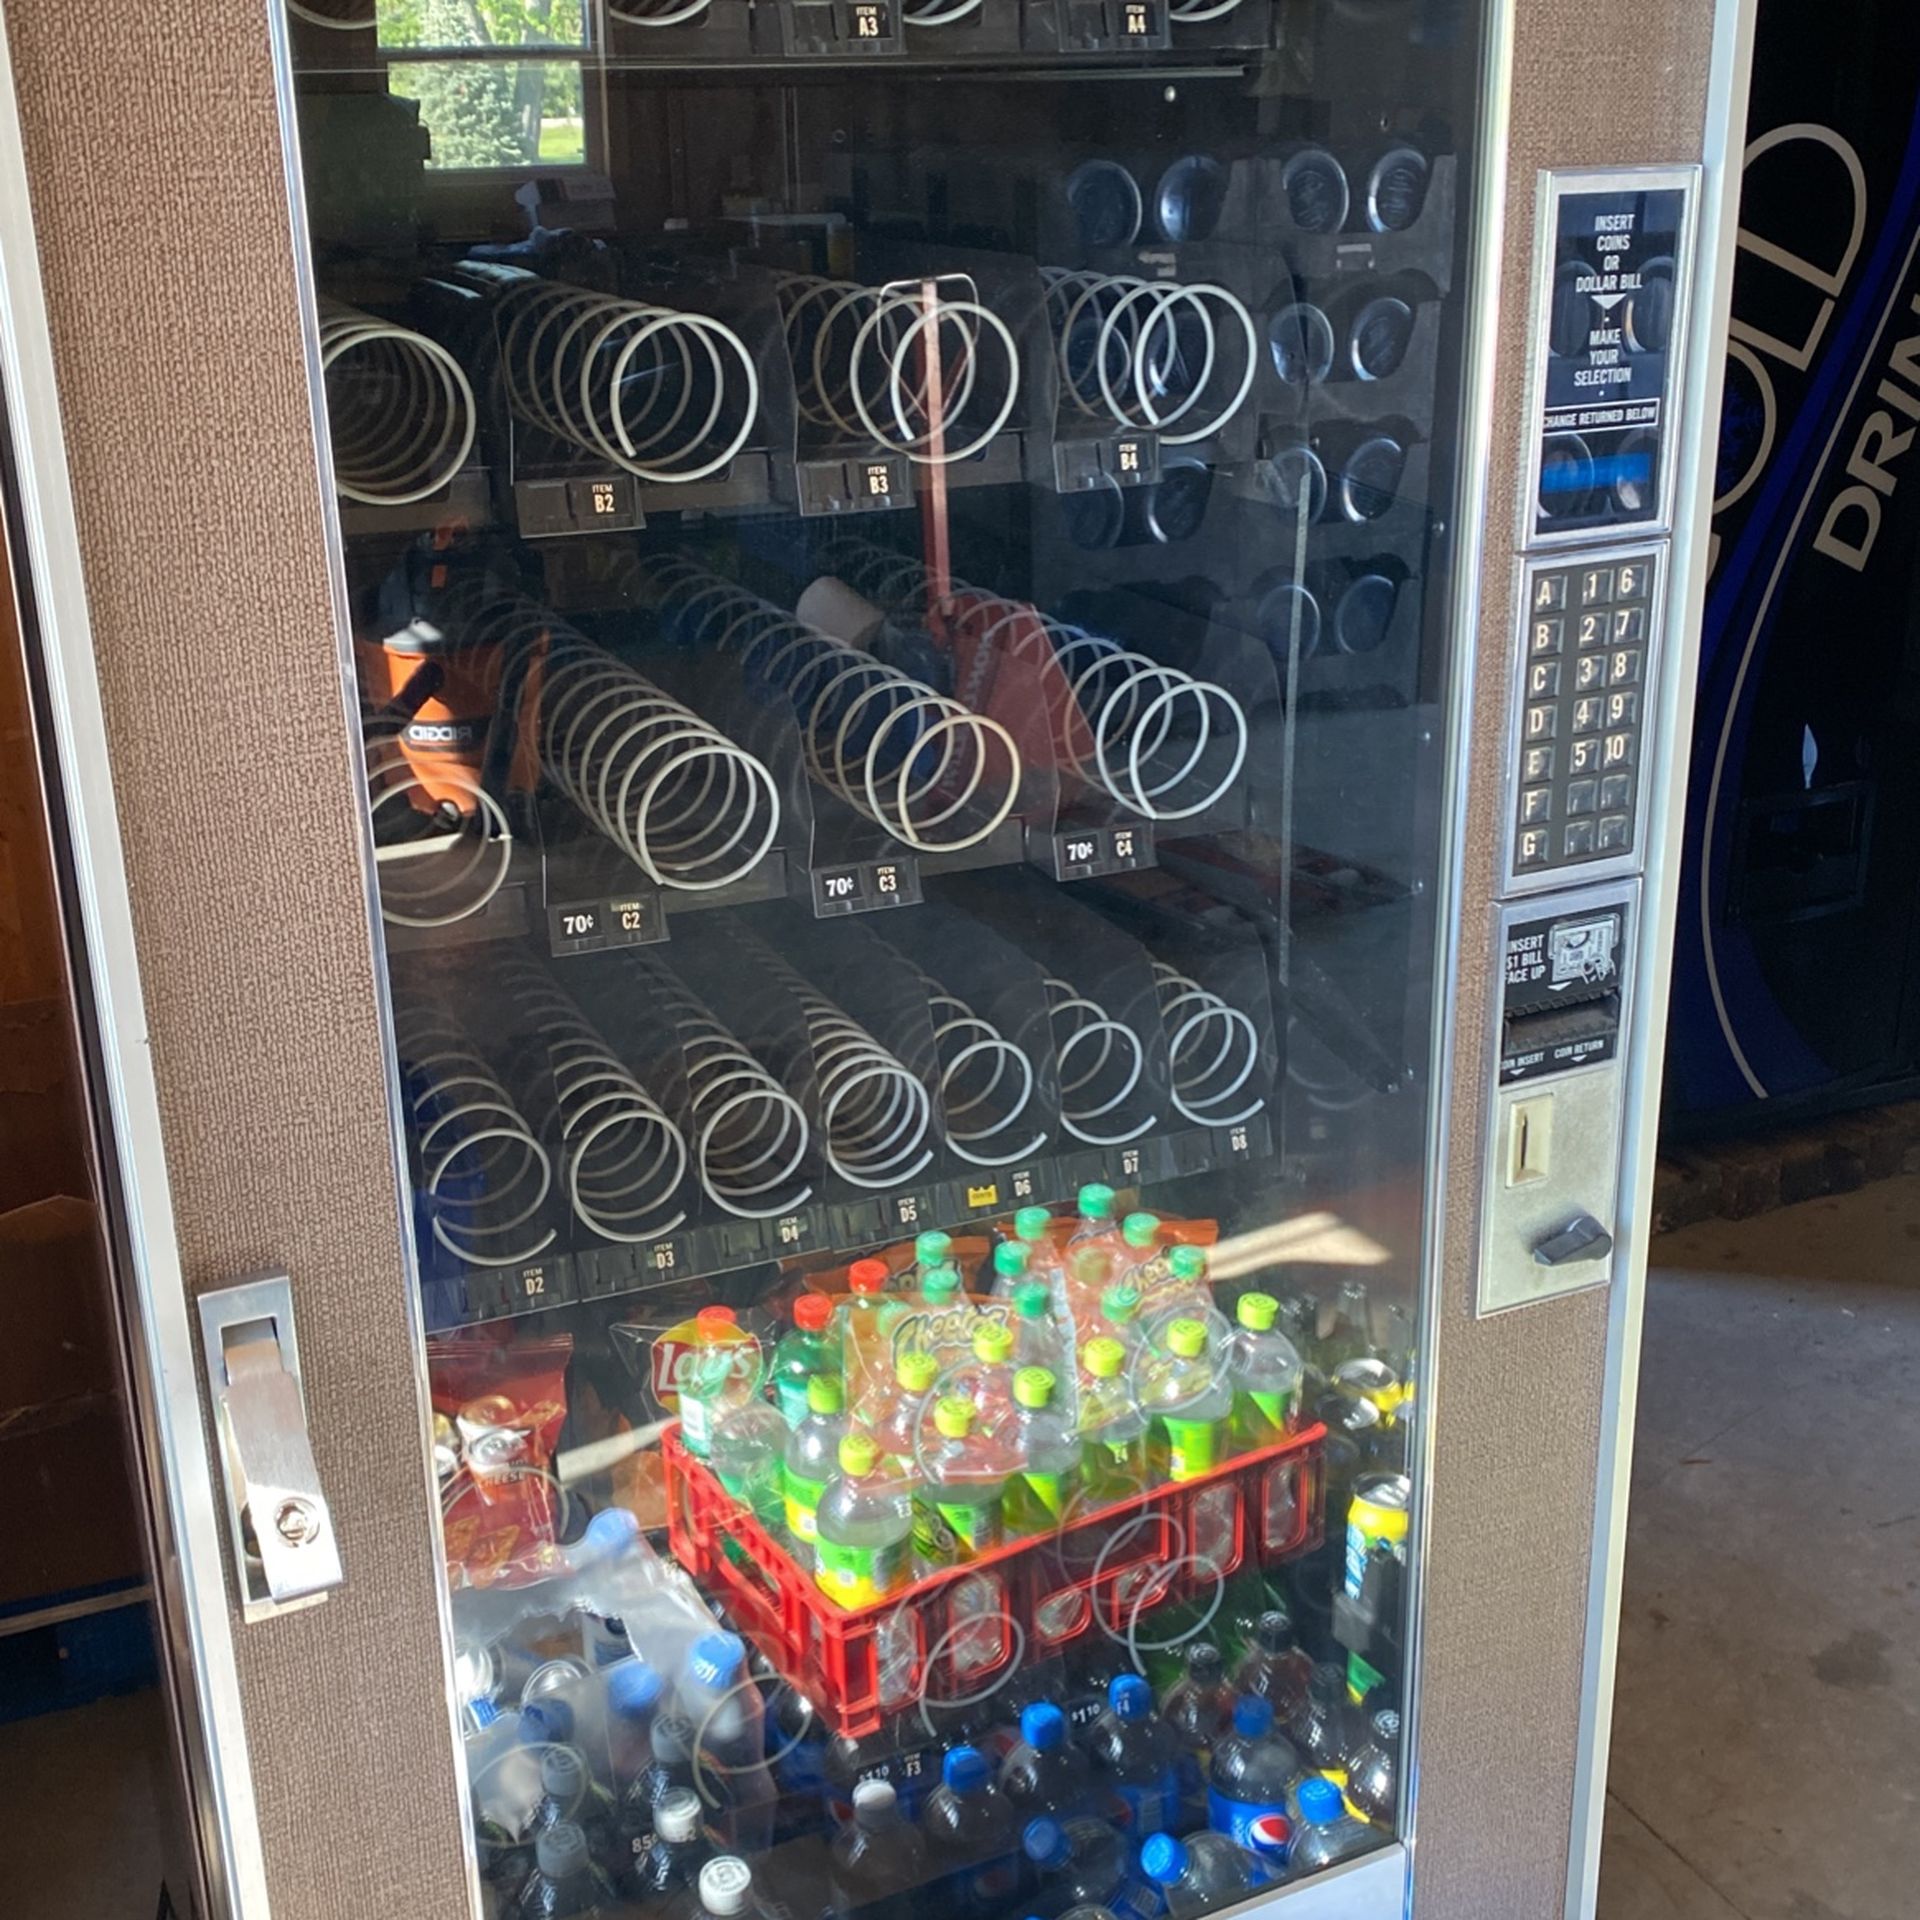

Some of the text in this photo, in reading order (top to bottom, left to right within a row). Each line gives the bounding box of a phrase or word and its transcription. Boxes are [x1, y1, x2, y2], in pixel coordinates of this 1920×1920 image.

[859, 18, 878, 36] A3
[1127, 15, 1147, 33] A4
[1595, 214, 1635, 231] INSERT
[1597, 234, 1630, 251] COINS
[1604, 255, 1619, 270] OR
[1575, 273, 1642, 293] DOLLAR BILL
[1590, 328, 1621, 346] MAKE
[1590, 349, 1619, 366] YOUR
[1705, 122, 1867, 590] OLD
[1574, 367, 1632, 386] SELECTION
[1579, 409, 1624, 426] RETURNED
[1626, 406, 1656, 421] BELOW
[1120, 452, 1138, 470] B4
[870, 475, 889, 494] B3
[594, 494, 615, 513] B2
[1588, 574, 1597, 598] 1
[1620, 568, 1633, 593] 6
[1538, 581, 1551, 605] A
[1581, 617, 1595, 642] 2
[1617, 611, 1630, 635] 7
[1536, 624, 1549, 648] B
[1580, 659, 1592, 683] 3
[1614, 652, 1627, 678] 8
[1533, 667, 1546, 691] C
[1576, 701, 1589, 725] 4
[1611, 695, 1624, 719] 9
[1530, 709, 1544, 733] D
[1574, 743, 1586, 766] 5
[1605, 736, 1624, 760] 10
[1528, 751, 1540, 775] E
[1525, 792, 1537, 816] F
[1522, 833, 1535, 857] G
[825, 876, 854, 897] 70¢
[879, 875, 897, 892] C3
[563, 914, 594, 935] 70¢
[622, 911, 641, 930] C2
[1521, 950, 1543, 967] BILL
[1531, 964, 1546, 980] UP
[1554, 1040, 1604, 1059] COIN RETURN
[1517, 1052, 1545, 1067] INSERT
[1123, 1156, 1139, 1174] D7
[900, 1204, 917, 1223] D5
[782, 1224, 799, 1243] D4
[656, 1250, 675, 1269] D3
[525, 1276, 545, 1295] D2
[906, 1760, 921, 1778] F3
